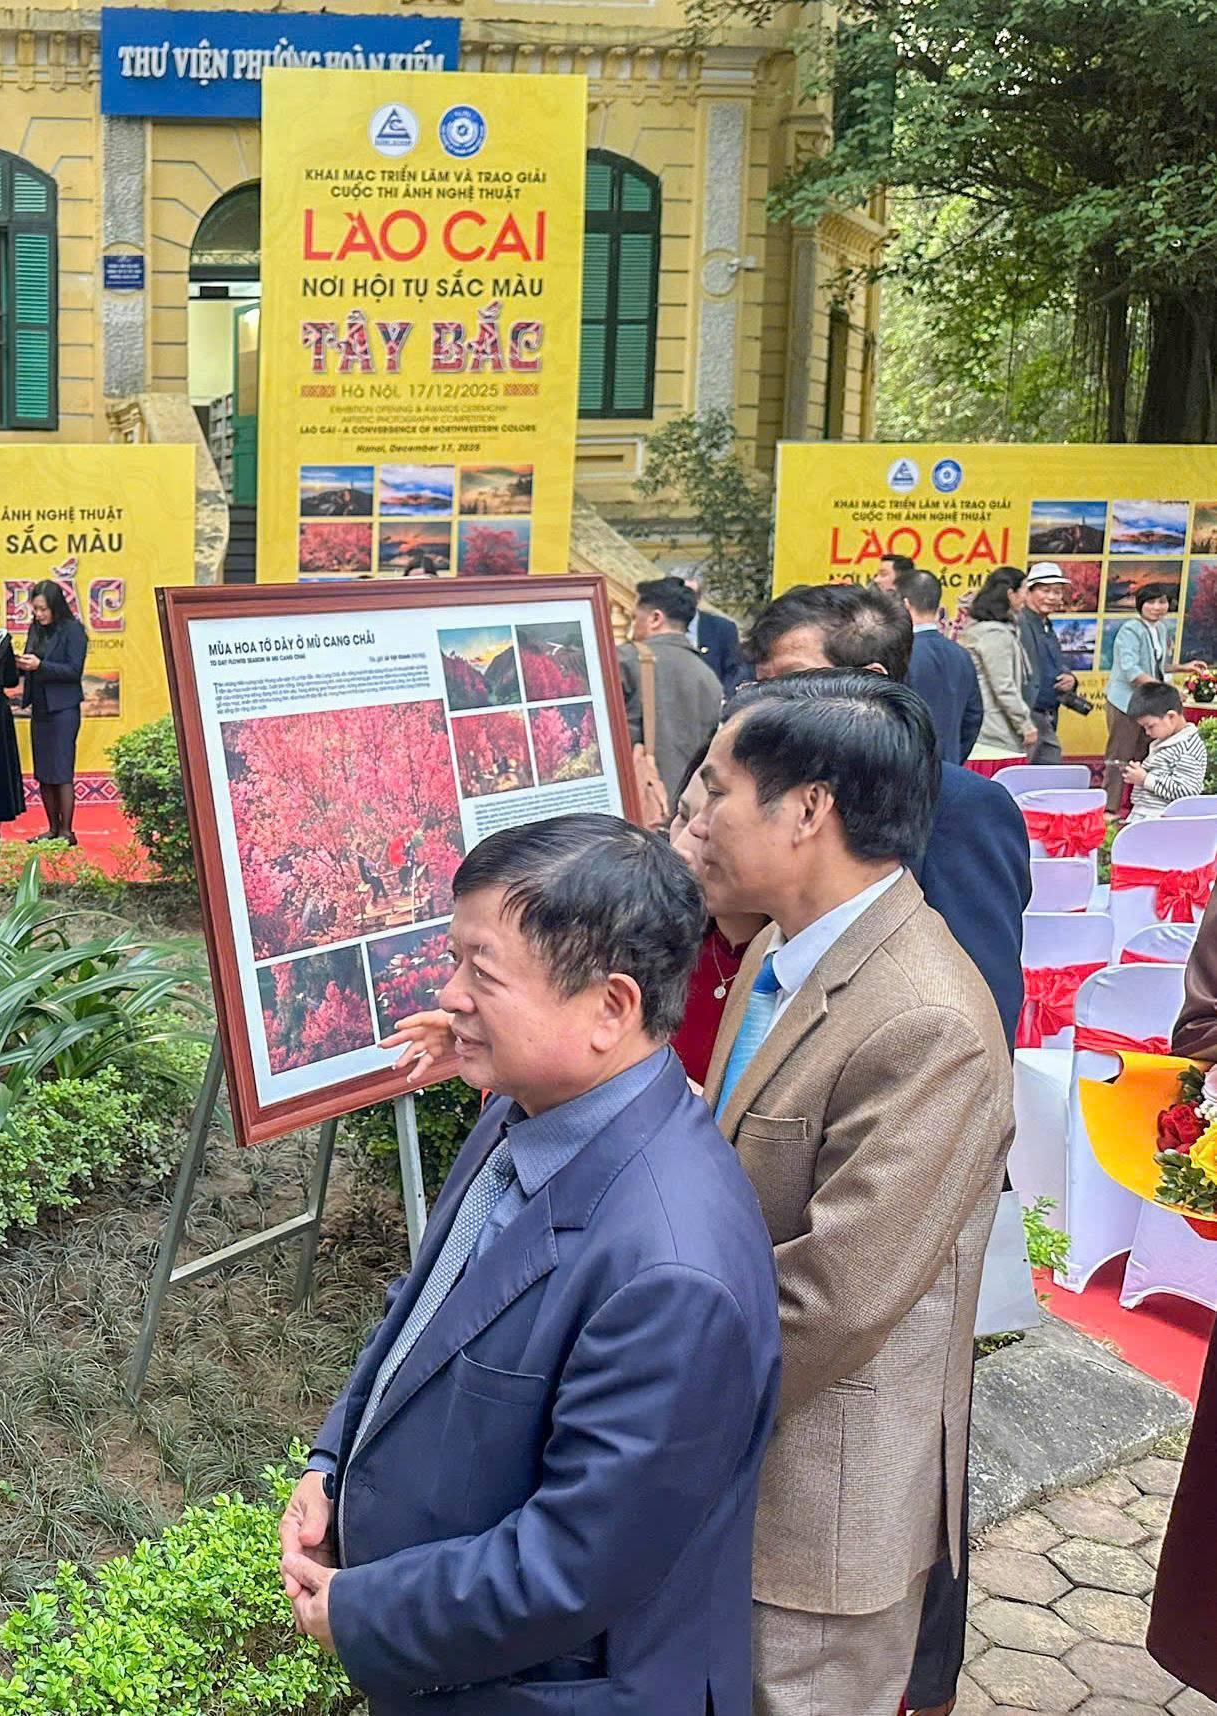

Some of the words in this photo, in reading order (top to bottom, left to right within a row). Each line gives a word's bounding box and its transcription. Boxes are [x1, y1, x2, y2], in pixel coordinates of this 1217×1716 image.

[119, 41, 169, 77] THƯ
[173, 38, 229, 86] VIỆN
[304, 169, 339, 181] KHAI
[343, 169, 375, 184] MẠC
[380, 165, 416, 182] TRIỂN
[421, 168, 449, 183] LÃM
[453, 168, 473, 183] VÀ
[477, 171, 512, 183] TRAO
[516, 168, 546, 183] GIẢI
[330, 184, 374, 201] CUỘC
[377, 187, 399, 199] THI
[403, 183, 432, 199] ẢNH
[436, 184, 474, 203] NGHỆ
[478, 185, 521, 204] THUẬT
[303, 208, 427, 262] LÀO
[442, 210, 545, 262] CAI
[303, 276, 344, 297] NƠI
[353, 273, 394, 303] HỘI
[402, 278, 428, 303] TỤ
[436, 269, 483, 297] SẮC
[491, 273, 543, 297] MÀU
[302, 308, 414, 373] TÂY
[431, 300, 544, 373] BẮC
[341, 384, 364, 398] Hà
[409, 383, 499, 399] 17/12/2025
[1, 506, 31, 521] ẢNH
[36, 507, 75, 523] NGHỆ
[79, 506, 123, 523] THUẬT
[6, 524, 58, 554] SẮC
[67, 527, 123, 553] MÀU
[830, 527, 922, 565] LÀO
[933, 527, 1010, 565] CAI
[208, 641, 232, 656] MÙA
[235, 642, 255, 655] HOA
[259, 637, 272, 653] TỚ
[274, 637, 293, 651] DÀY
[296, 635, 304, 650] Ở
[307, 635, 321, 649] MÙ
[323, 635, 351, 647] CANG
[354, 630, 375, 646] CHẢI
